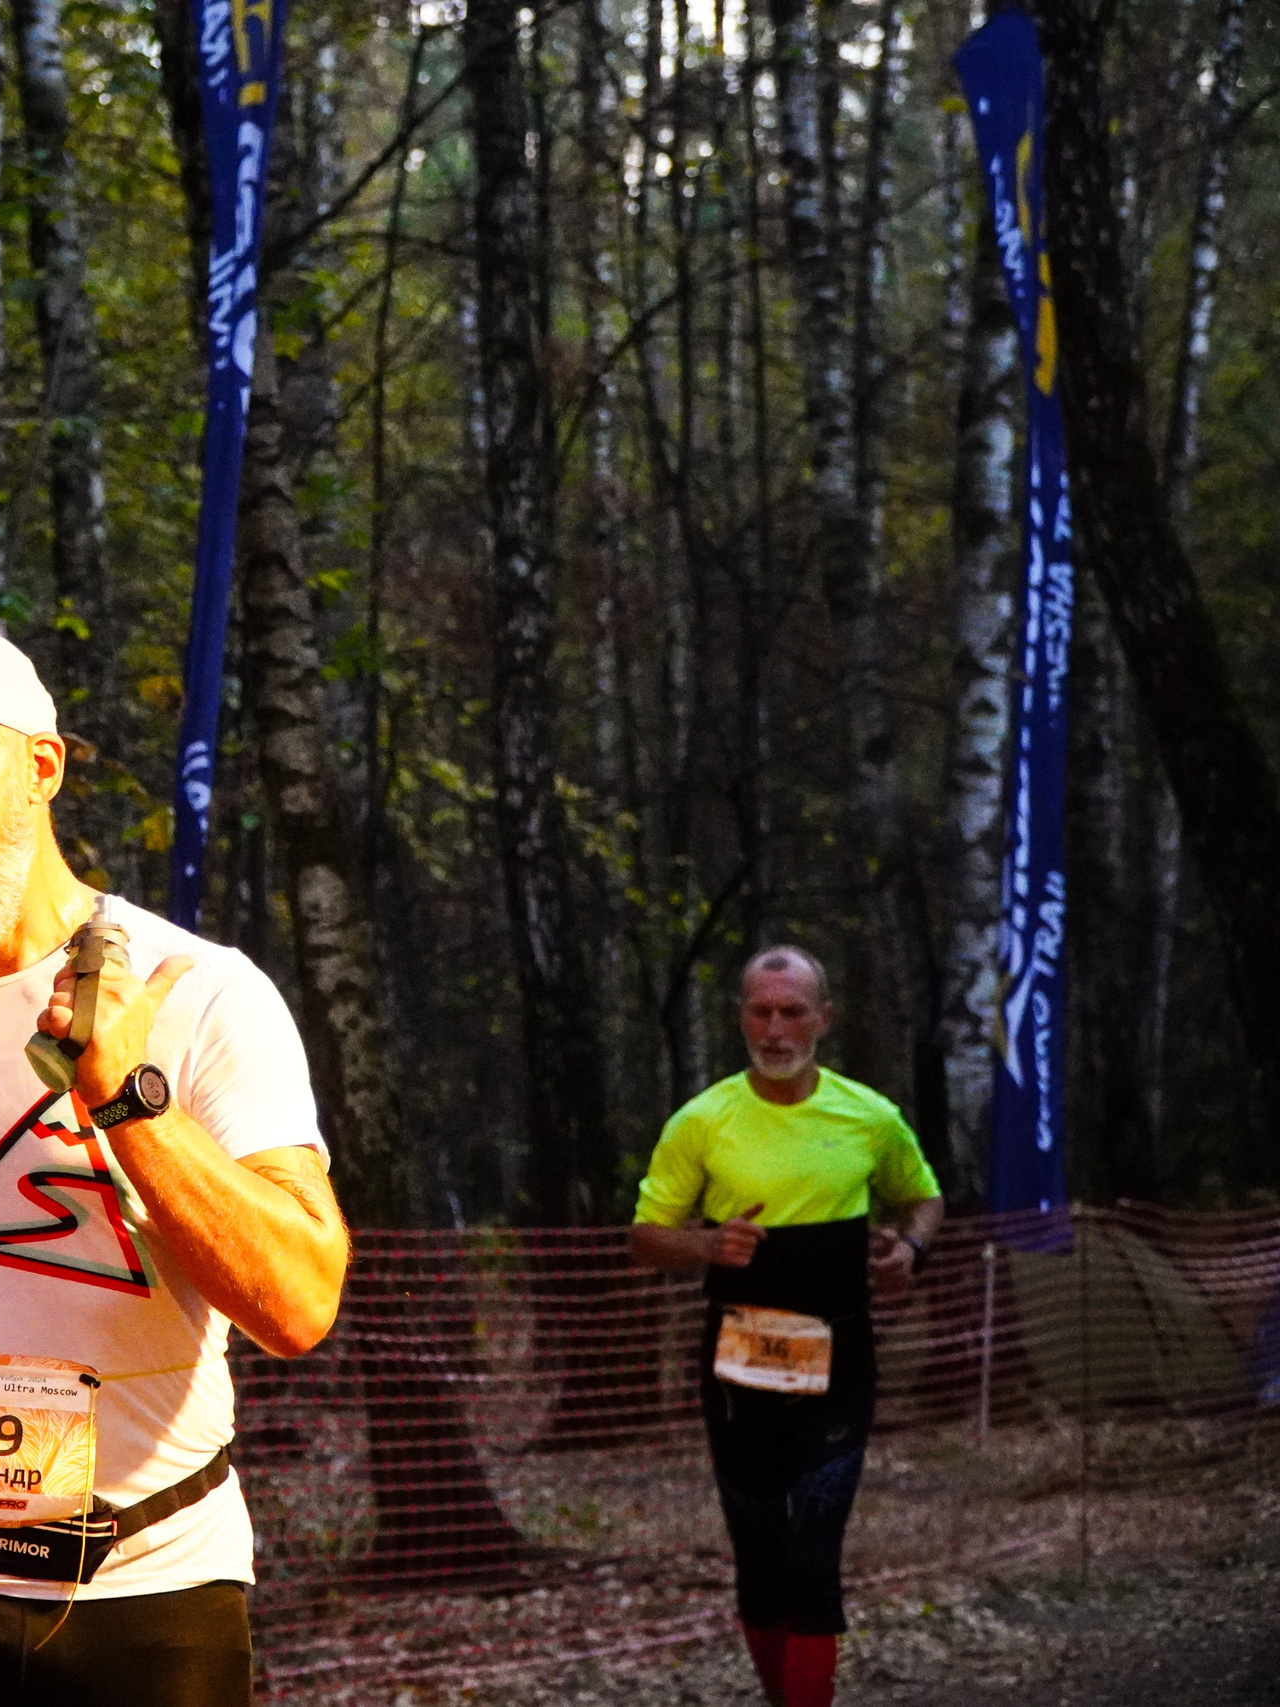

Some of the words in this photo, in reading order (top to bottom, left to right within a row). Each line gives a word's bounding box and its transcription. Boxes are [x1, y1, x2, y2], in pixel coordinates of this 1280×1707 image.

[28, 1376, 47, 1384] 2024
[4, 1383, 35, 1394] Ultra
[41, 1386, 78, 1397] Moscow
